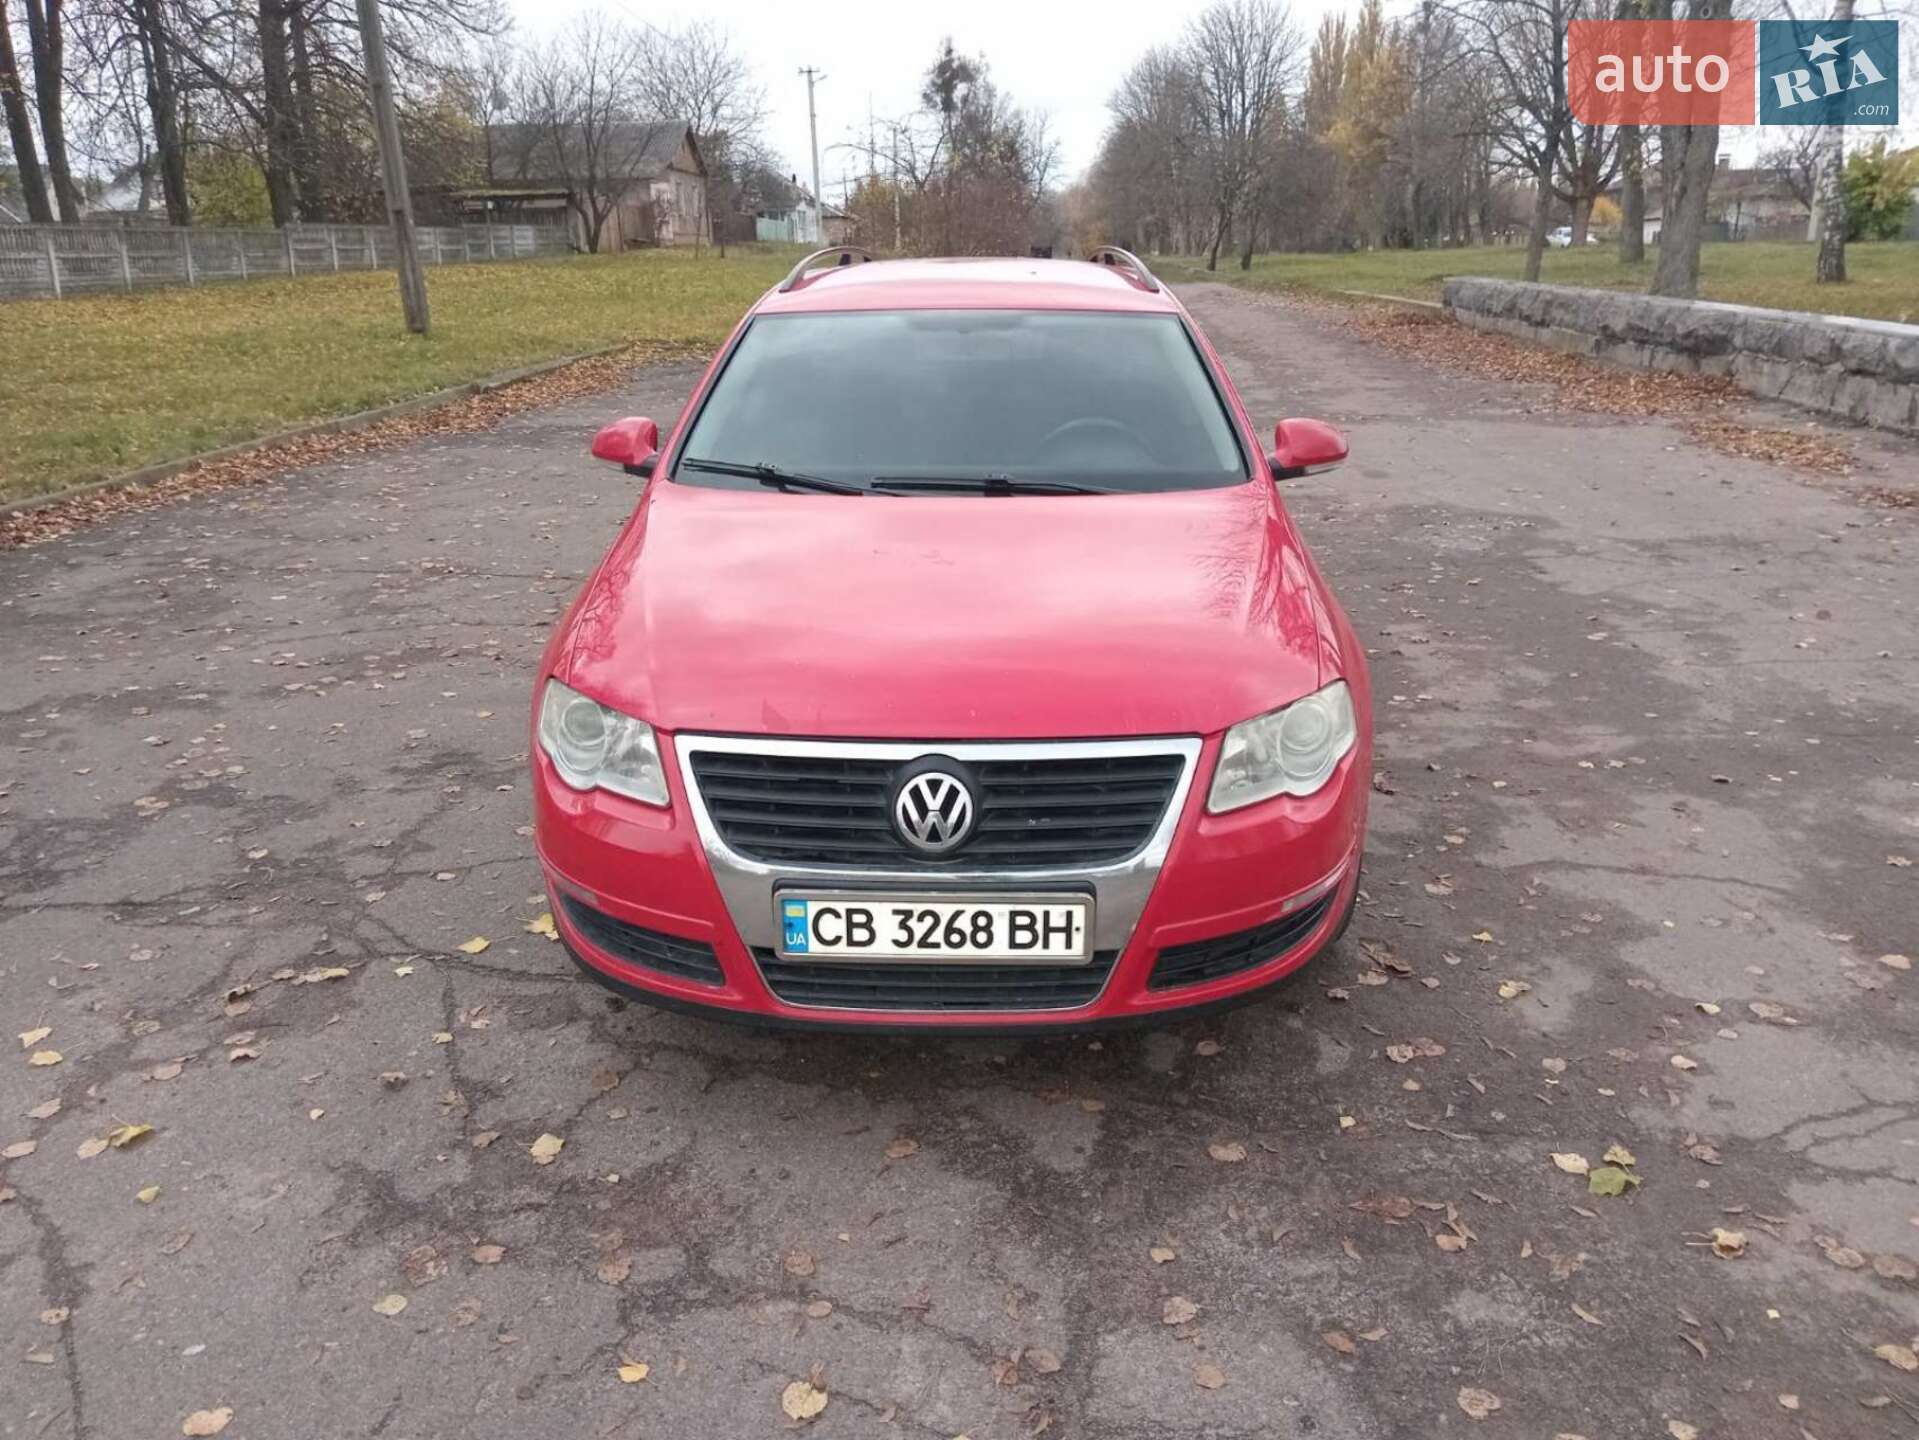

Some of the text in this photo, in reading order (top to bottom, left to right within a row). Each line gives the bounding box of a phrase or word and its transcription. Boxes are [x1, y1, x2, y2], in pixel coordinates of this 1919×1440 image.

[785, 932, 807, 946] UA
[811, 907, 1074, 950] CB 3268 BH
